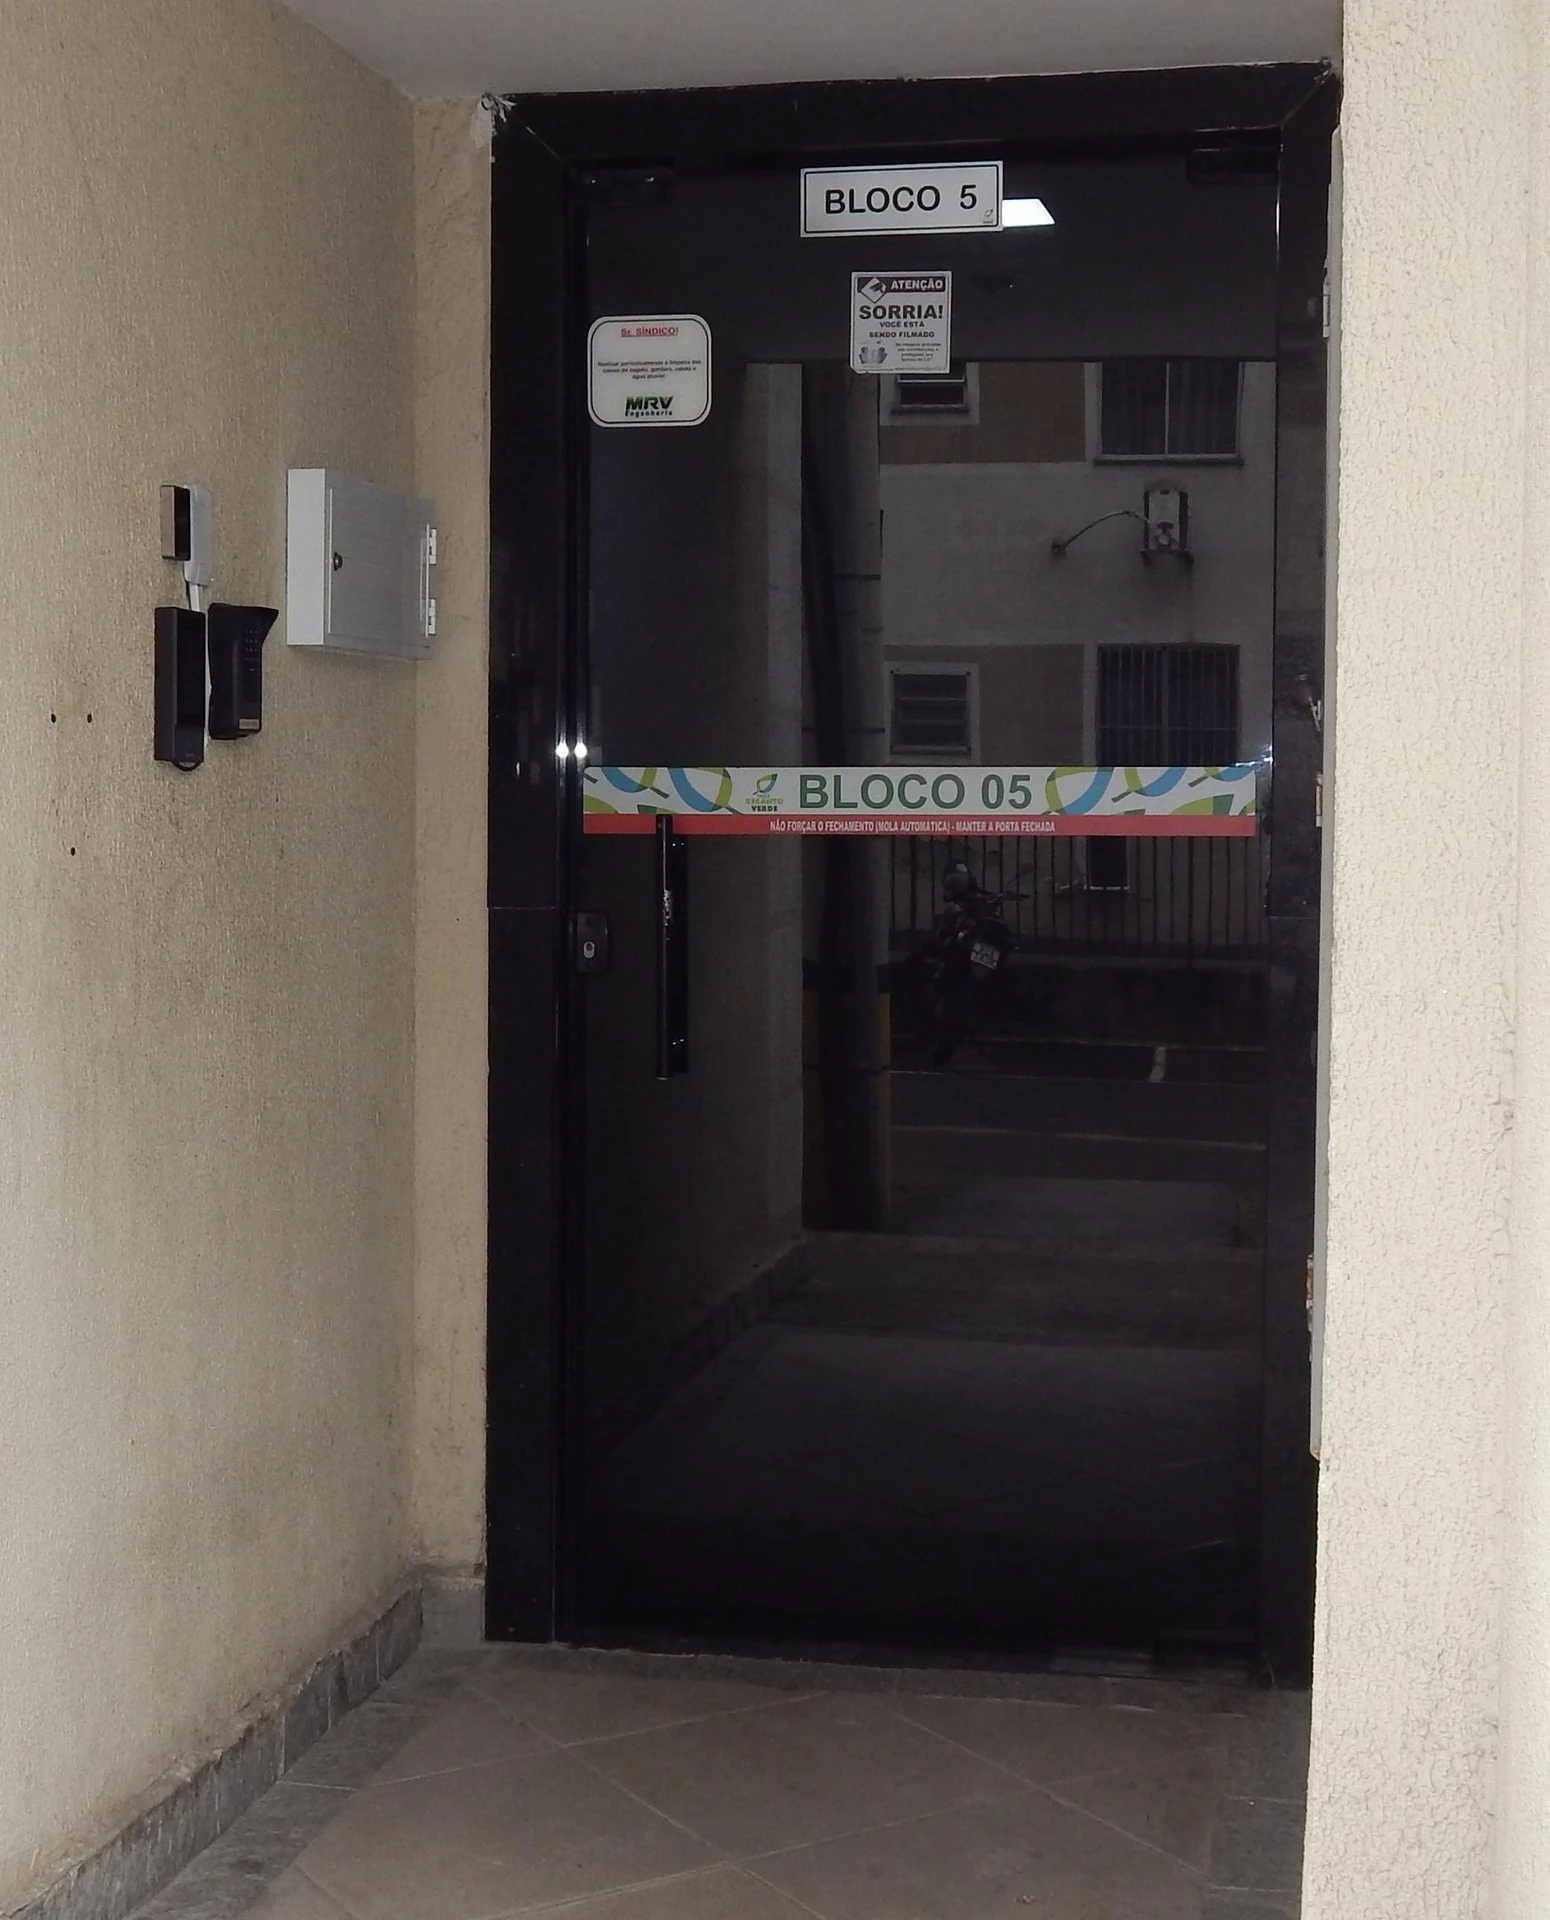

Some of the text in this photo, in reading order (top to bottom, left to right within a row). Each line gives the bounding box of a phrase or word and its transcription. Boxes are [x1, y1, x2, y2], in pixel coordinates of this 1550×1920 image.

[825, 184, 977, 214] BLOCO 5
[890, 278, 943, 291] ATENÇÃO
[859, 304, 944, 320] SORRIA!
[625, 396, 674, 410] MRV
[799, 773, 1032, 809] BLOCO 05
[770, 819, 786, 832] NÃO
[787, 821, 816, 833] FORÇAR
[817, 821, 823, 831] O
[825, 821, 874, 832] FECHAMENTO
[875, 821, 899, 833] (MOLA
[955, 821, 986, 832] MANTER
[988, 821, 994, 832] A
[995, 821, 1018, 832] PORTA
[1021, 821, 1056, 832] FECHADA
